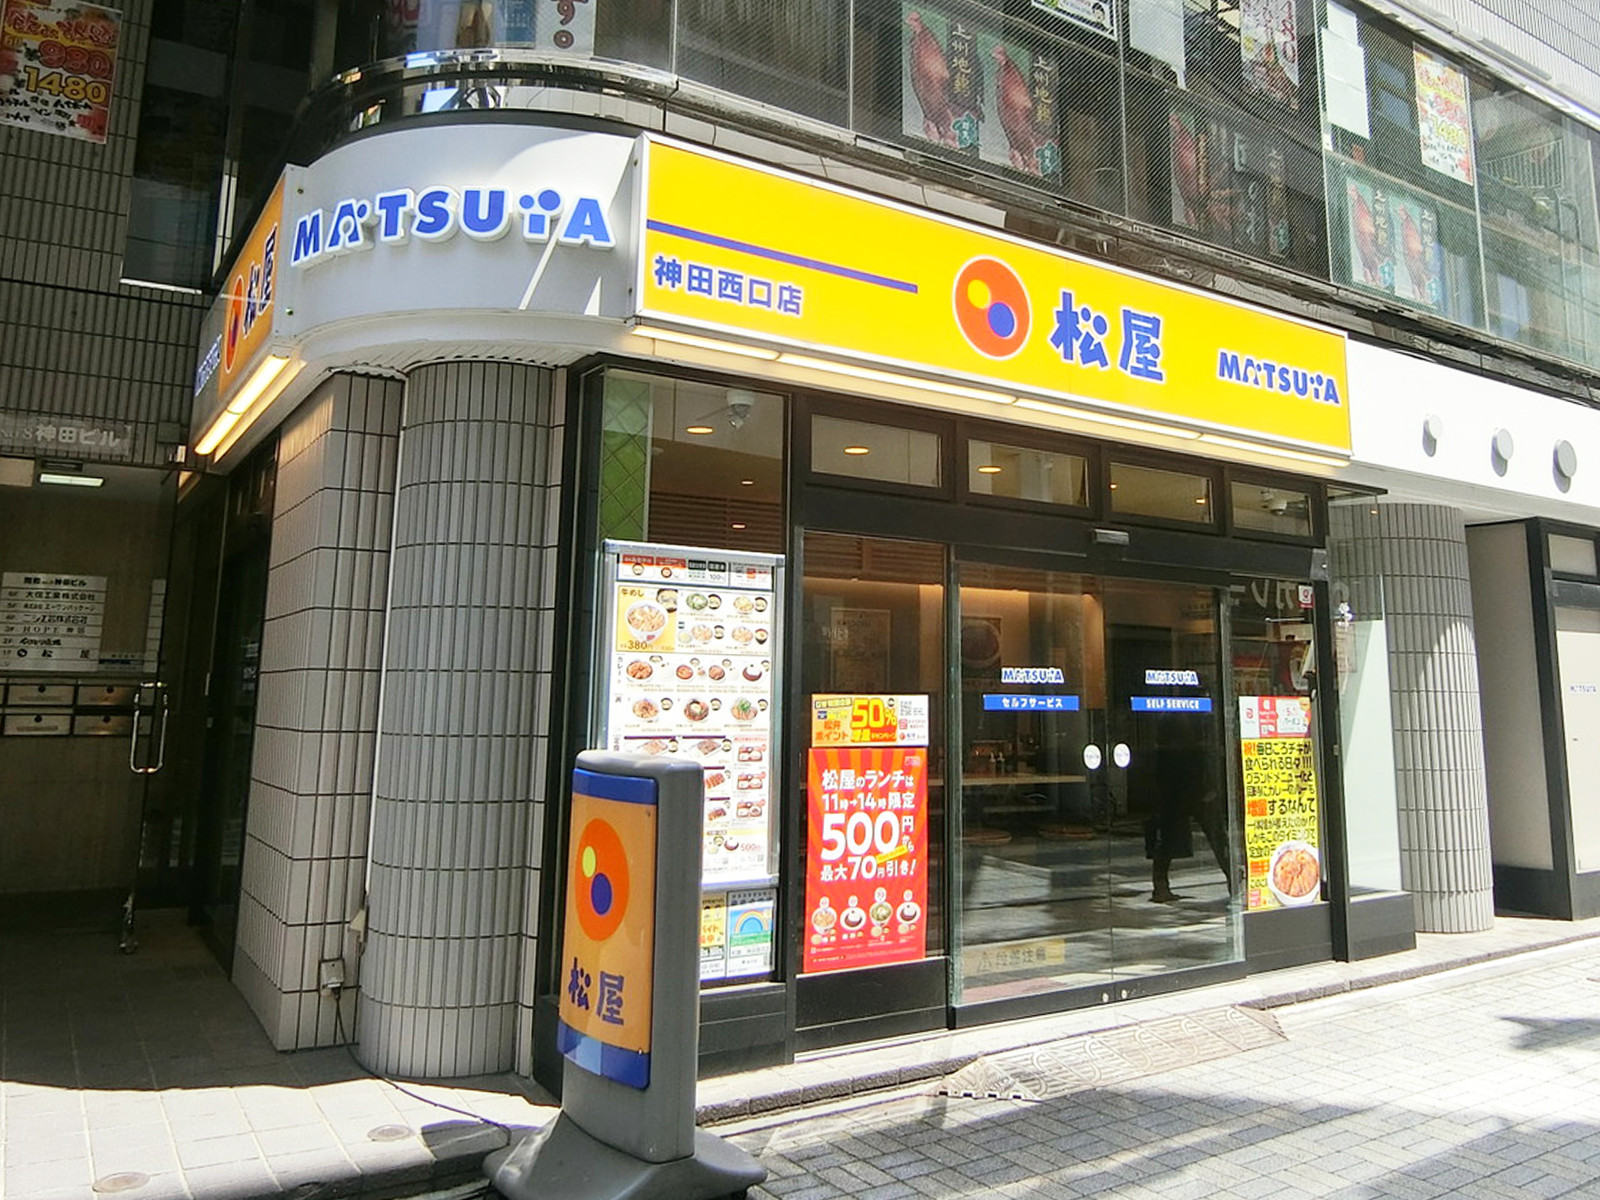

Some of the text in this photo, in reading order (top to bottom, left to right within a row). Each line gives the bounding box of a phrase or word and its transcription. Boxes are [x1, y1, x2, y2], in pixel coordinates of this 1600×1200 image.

[24, 65, 107, 104] 1480
[291, 187, 614, 267] MATSUYA
[654, 255, 803, 316] 神田西口店
[1051, 290, 1166, 383] 松屋
[1217, 350, 1342, 406] MATSUYA
[36, 424, 121, 448] 神田ビル
[627, 640, 648, 649] 380
[1002, 668, 1064, 683] MATSUYA
[1145, 670, 1199, 685] MATSUYA
[851, 697, 897, 730] 50%
[1002, 697, 1063, 708] セルフサービス
[1146, 698, 1199, 710] SELF SERVICE
[815, 730, 848, 741] ポイント
[822, 768, 915, 791] 松屋のランチは
[820, 811, 900, 861] 500
[568, 956, 625, 1027] 松屋
